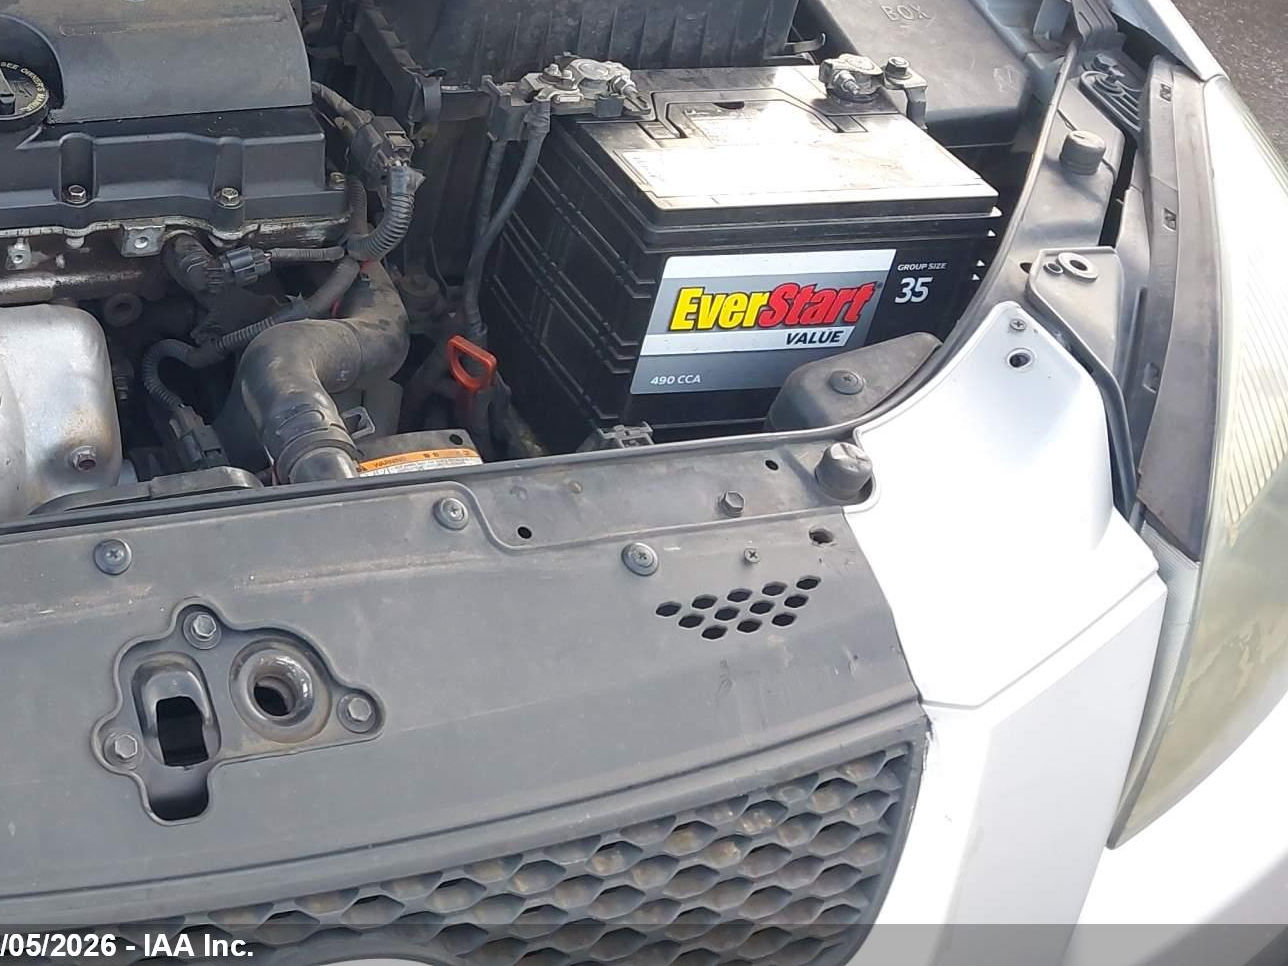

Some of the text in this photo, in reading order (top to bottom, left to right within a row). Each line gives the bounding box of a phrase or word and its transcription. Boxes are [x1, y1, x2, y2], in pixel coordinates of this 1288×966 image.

[880, 4, 931, 21] BOX
[0, 61, 20, 70] SEE
[897, 262, 948, 271] GROUP SIZE
[894, 277, 933, 303] 35
[669, 281, 878, 331] EverStart
[785, 329, 845, 346] VALUE
[650, 374, 701, 385] 490 CCA
